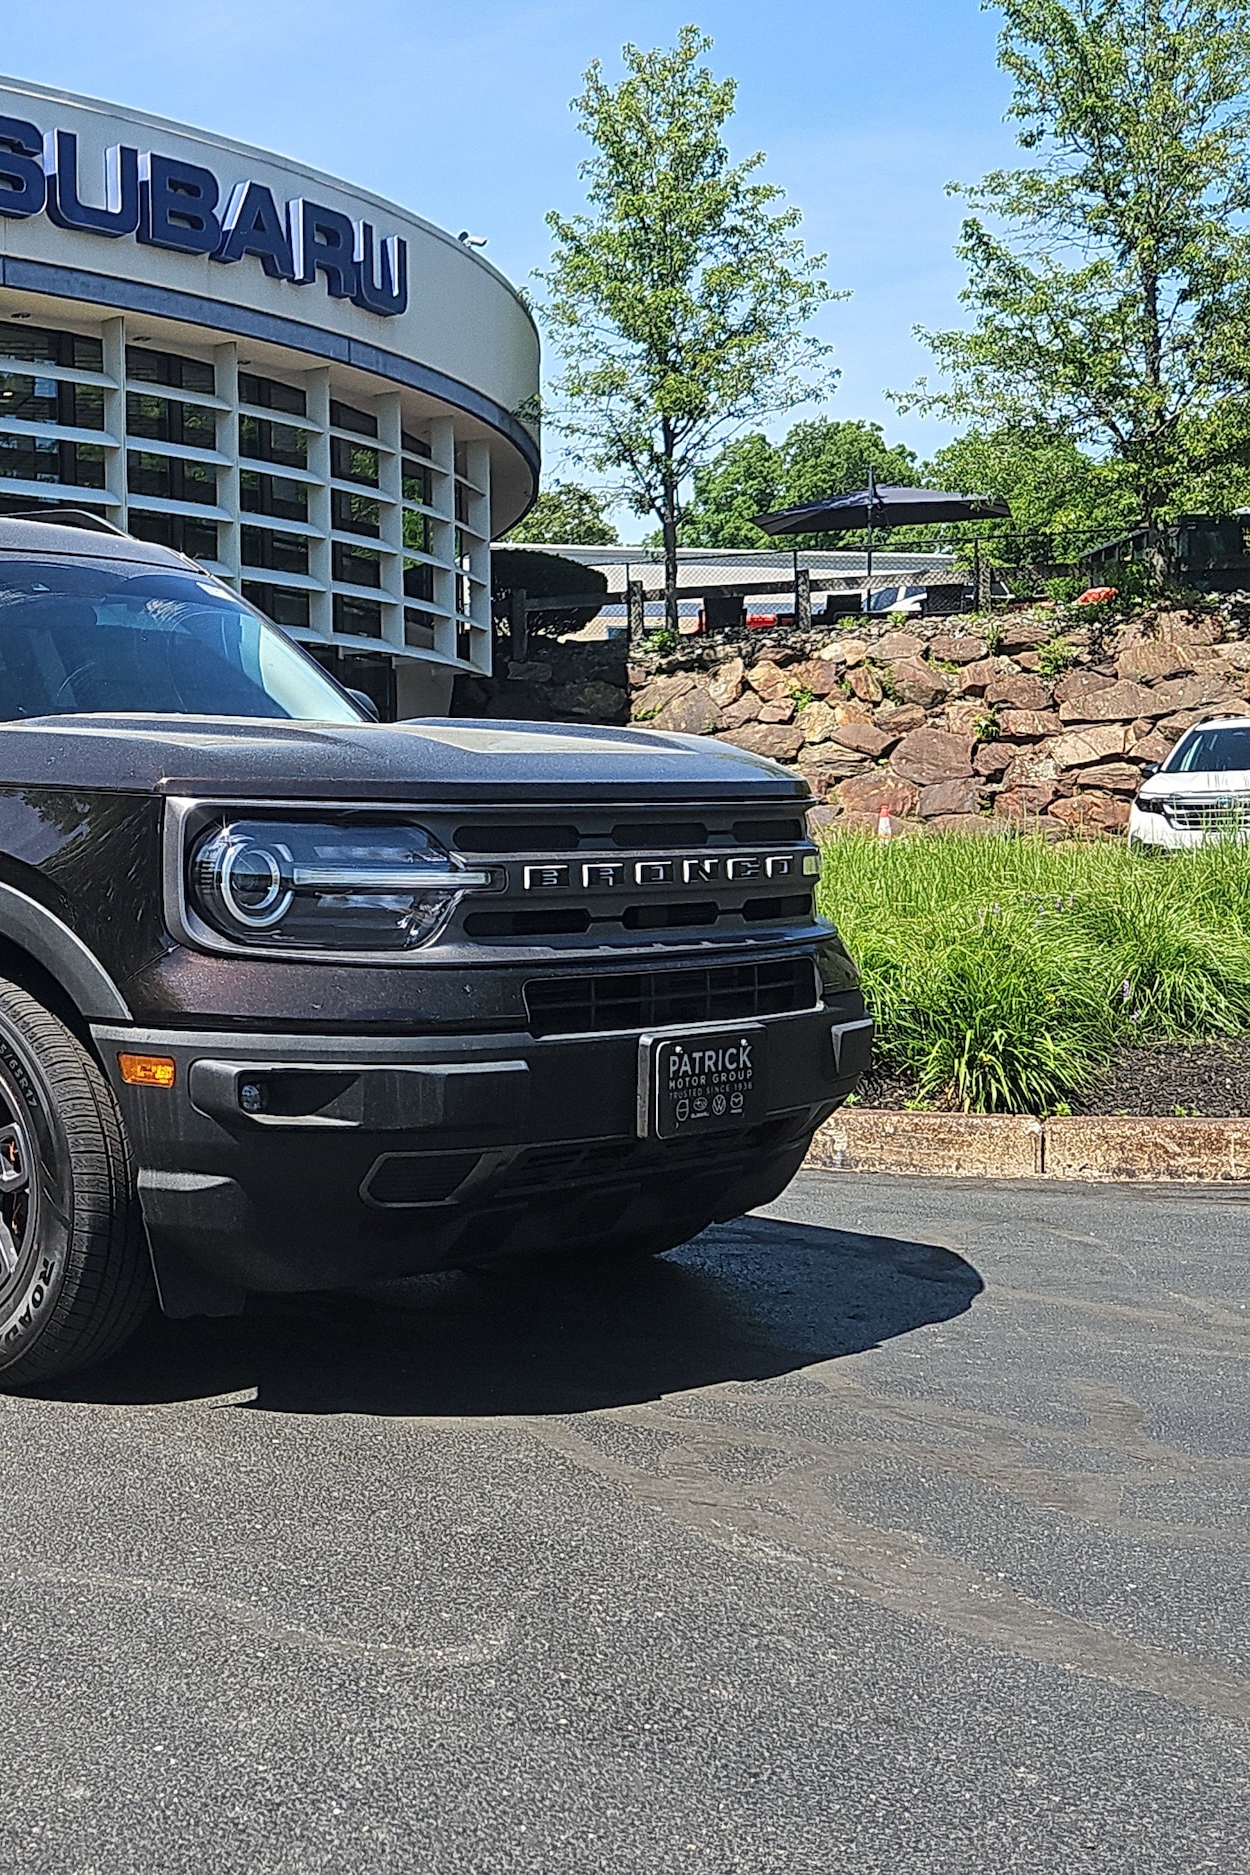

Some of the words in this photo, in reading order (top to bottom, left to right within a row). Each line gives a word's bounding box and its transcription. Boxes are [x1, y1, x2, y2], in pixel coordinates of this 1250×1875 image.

[523, 855, 795, 890] BRONCO
[669, 1045, 753, 1079] PATRICK
[668, 1075, 707, 1090] MOTOR
[712, 1069, 753, 1084] GROUP
[668, 1088, 703, 1099] TRUSTED
[705, 1084, 730, 1095] SINCE
